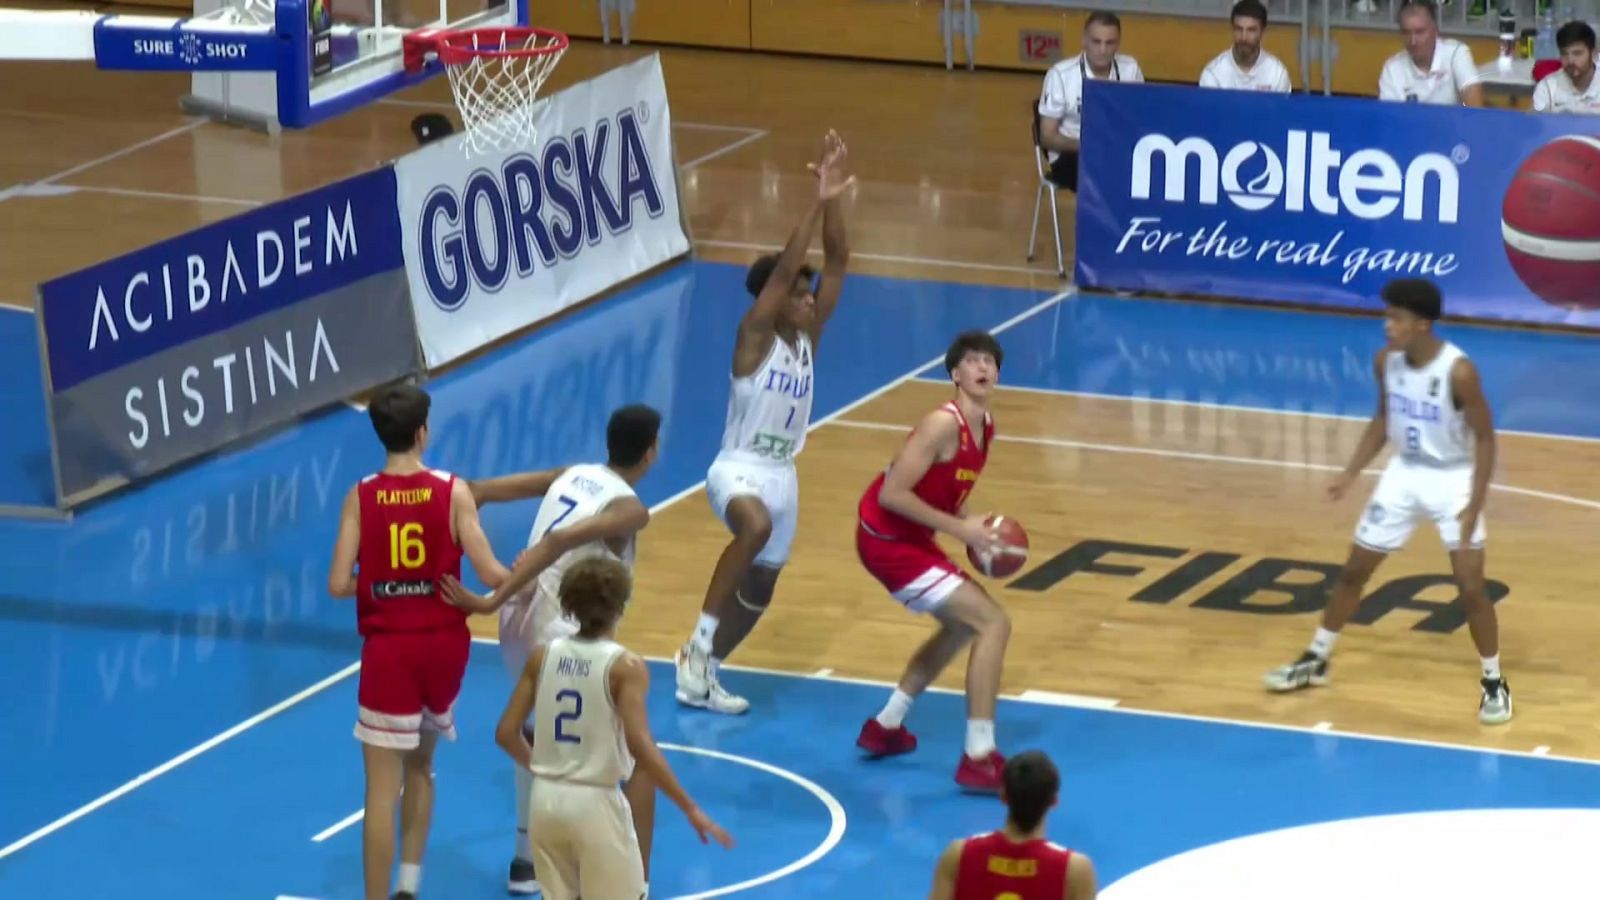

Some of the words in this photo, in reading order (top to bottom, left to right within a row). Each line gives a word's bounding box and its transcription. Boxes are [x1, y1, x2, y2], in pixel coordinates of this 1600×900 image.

[134, 39, 174, 55] SURE
[206, 43, 248, 58] SHOT
[418, 107, 664, 312] GORSKA
[1131, 129, 1460, 224] molten
[89, 198, 358, 350] ACIBADEM
[1115, 216, 1182, 254] For
[1186, 220, 1250, 259] the
[1256, 230, 1344, 266] real
[1342, 248, 1461, 284] game
[125, 317, 340, 449] SISTINA
[784, 405, 796, 430] 1
[389, 522, 426, 570] 16
[543, 494, 578, 538] 7
[1005, 539, 1510, 634] FIBA
[555, 688, 582, 744] 2
